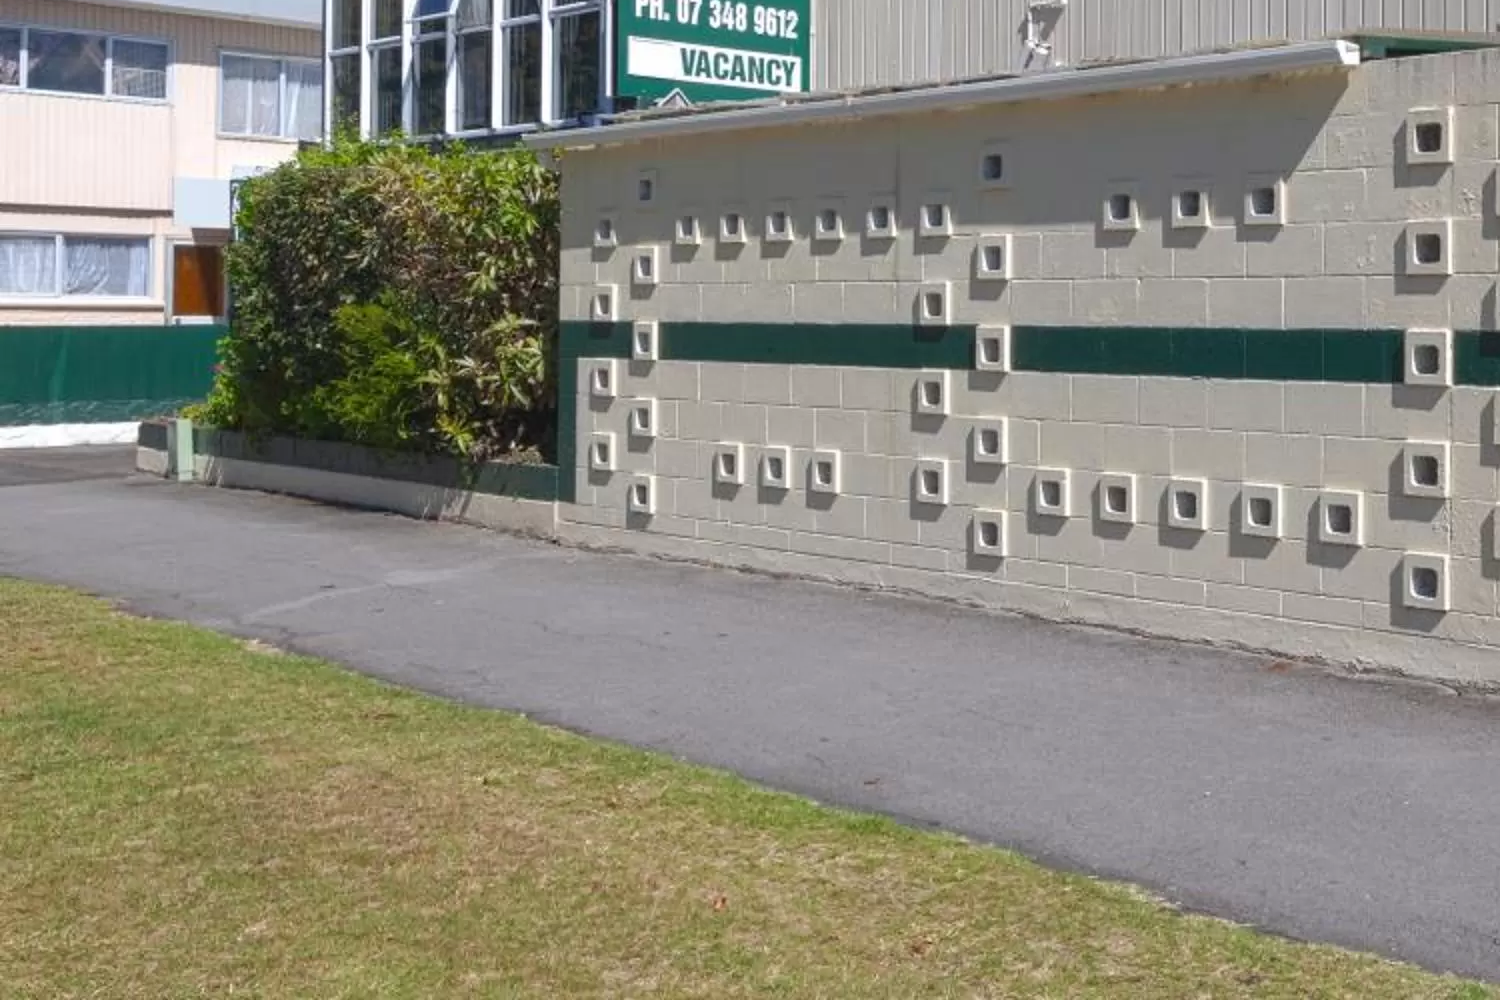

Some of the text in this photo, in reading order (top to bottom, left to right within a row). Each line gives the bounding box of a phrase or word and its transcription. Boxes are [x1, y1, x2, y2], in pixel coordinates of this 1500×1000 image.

[709, 0, 748, 32] 348
[753, 5, 799, 39] 9612
[680, 47, 796, 87] VACANCY
